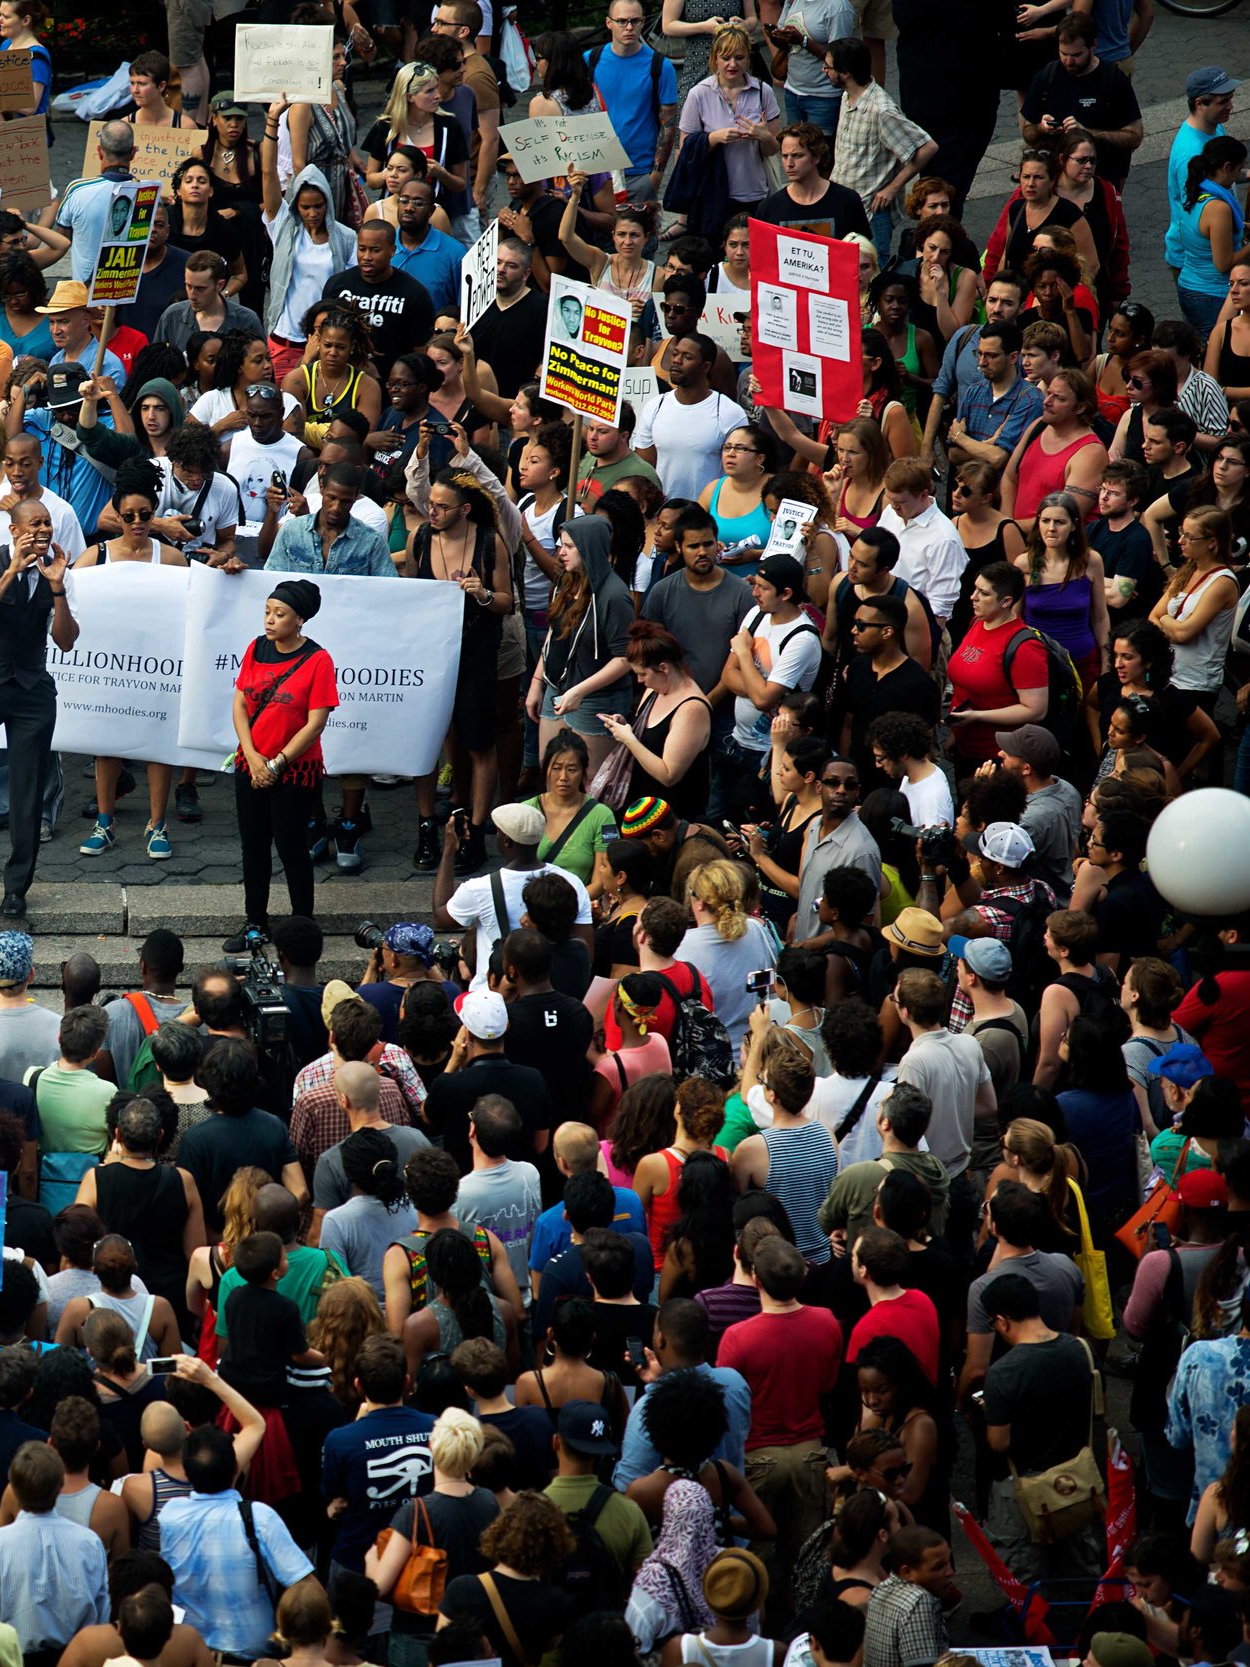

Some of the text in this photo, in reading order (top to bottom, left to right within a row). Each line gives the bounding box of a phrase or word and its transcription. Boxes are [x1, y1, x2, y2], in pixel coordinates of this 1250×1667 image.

[141, 131, 190, 144] injustice
[515, 135, 549, 151] SELF
[146, 143, 168, 155] the
[554, 146, 604, 161] RACISM
[21, 153, 41, 165] the
[132, 167, 153, 175] our
[105, 247, 136, 267] JAIL
[791, 247, 815, 260] ET TU,
[784, 258, 824, 273] AMERIKA?
[96, 268, 140, 279] Zimmerman
[585, 306, 626, 328] No Justice
[598, 323, 611, 335] for
[585, 331, 622, 351] Trayvon?
[551, 346, 620, 382] No Peace for
[548, 359, 618, 396] Zimmerman!
[596, 396, 616, 412] Party
[783, 508, 805, 517] JUSTICE
[78, 674, 157, 691] FOR TRAYVON
[358, 693, 404, 702] MARTIN
[63, 701, 167, 720] www.mhoodies.org
[365, 1432, 432, 1450] MOUTH SHUT
